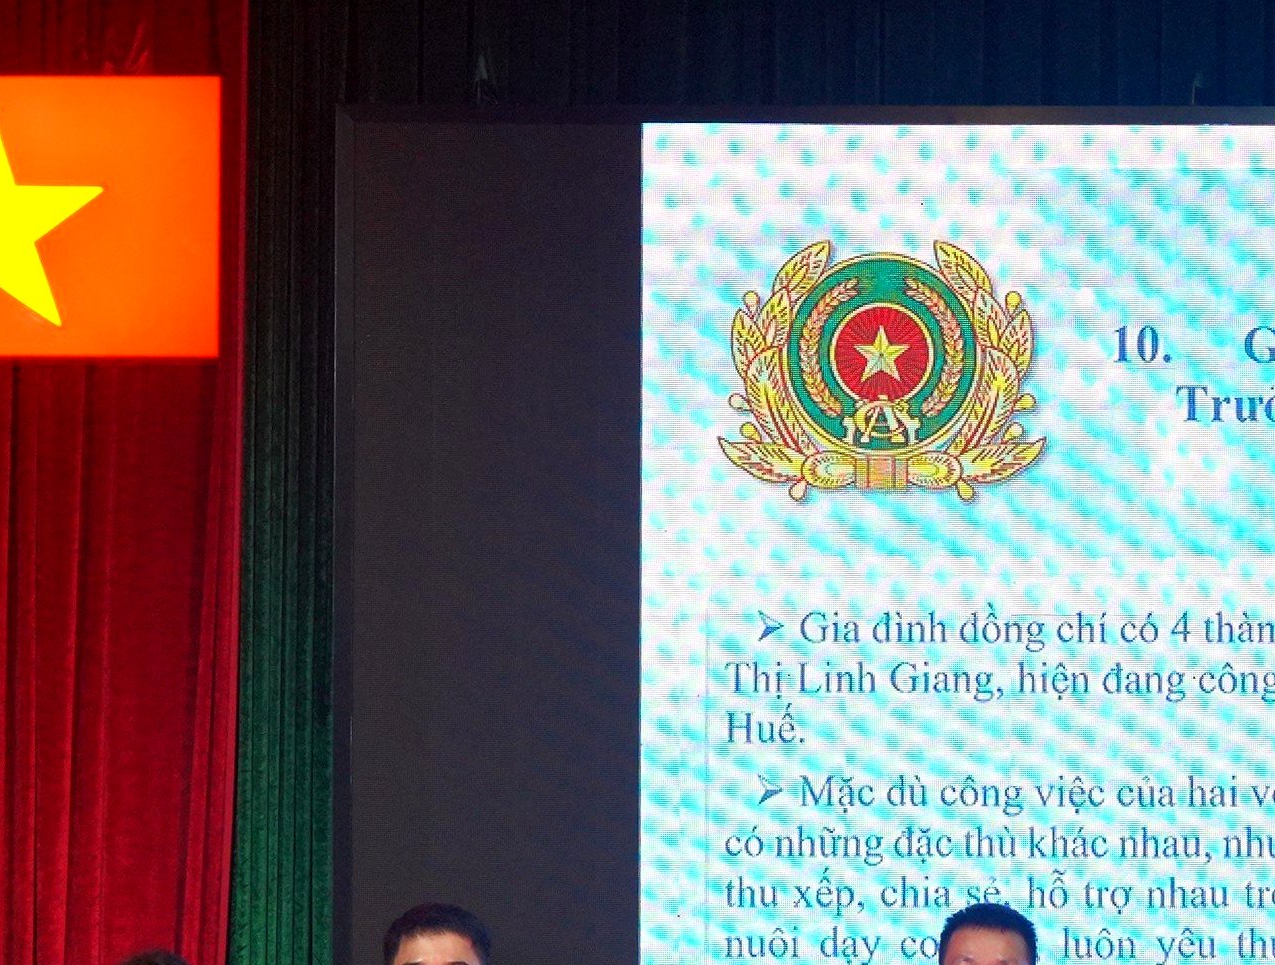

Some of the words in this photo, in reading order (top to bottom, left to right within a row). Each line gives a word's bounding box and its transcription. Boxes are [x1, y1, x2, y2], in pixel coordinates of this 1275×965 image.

[1113, 325, 1172, 364] 10.
[800, 611, 861, 644] Gia
[872, 610, 948, 644] đình
[1056, 611, 1107, 644] chí
[1120, 611, 1160, 644] có
[1170, 612, 1191, 643] 4
[725, 661, 784, 700] Thị
[797, 661, 877, 694] Linh
[890, 661, 1005, 702] Giang,
[1017, 661, 1090, 701] hiện
[1102, 662, 1186, 702] đang
[725, 703, 805, 745] Huế.
[800, 774, 876, 814] Mặc
[886, 775, 928, 808] dù
[940, 776, 1024, 816] công
[1036, 776, 1106, 815] việc
[1116, 775, 1176, 808] của
[1188, 776, 1238, 810] hai
[725, 825, 764, 859] có
[774, 825, 885, 867] những
[893, 826, 953, 865] đặc
[963, 826, 1017, 859] thù
[1027, 826, 1109, 859] khác
[1119, 826, 1212, 864] nhau,
[725, 876, 779, 908] thu
[793, 870, 865, 917] xếp,
[880, 876, 952, 908] chia
[1027, 868, 1070, 908] hỗ
[1084, 883, 1130, 916] trợ
[1146, 877, 1230, 909] nhau
[725, 927, 800, 960] nuôi
[900, 936, 938, 960] co
[1063, 927, 1136, 960] luôn
